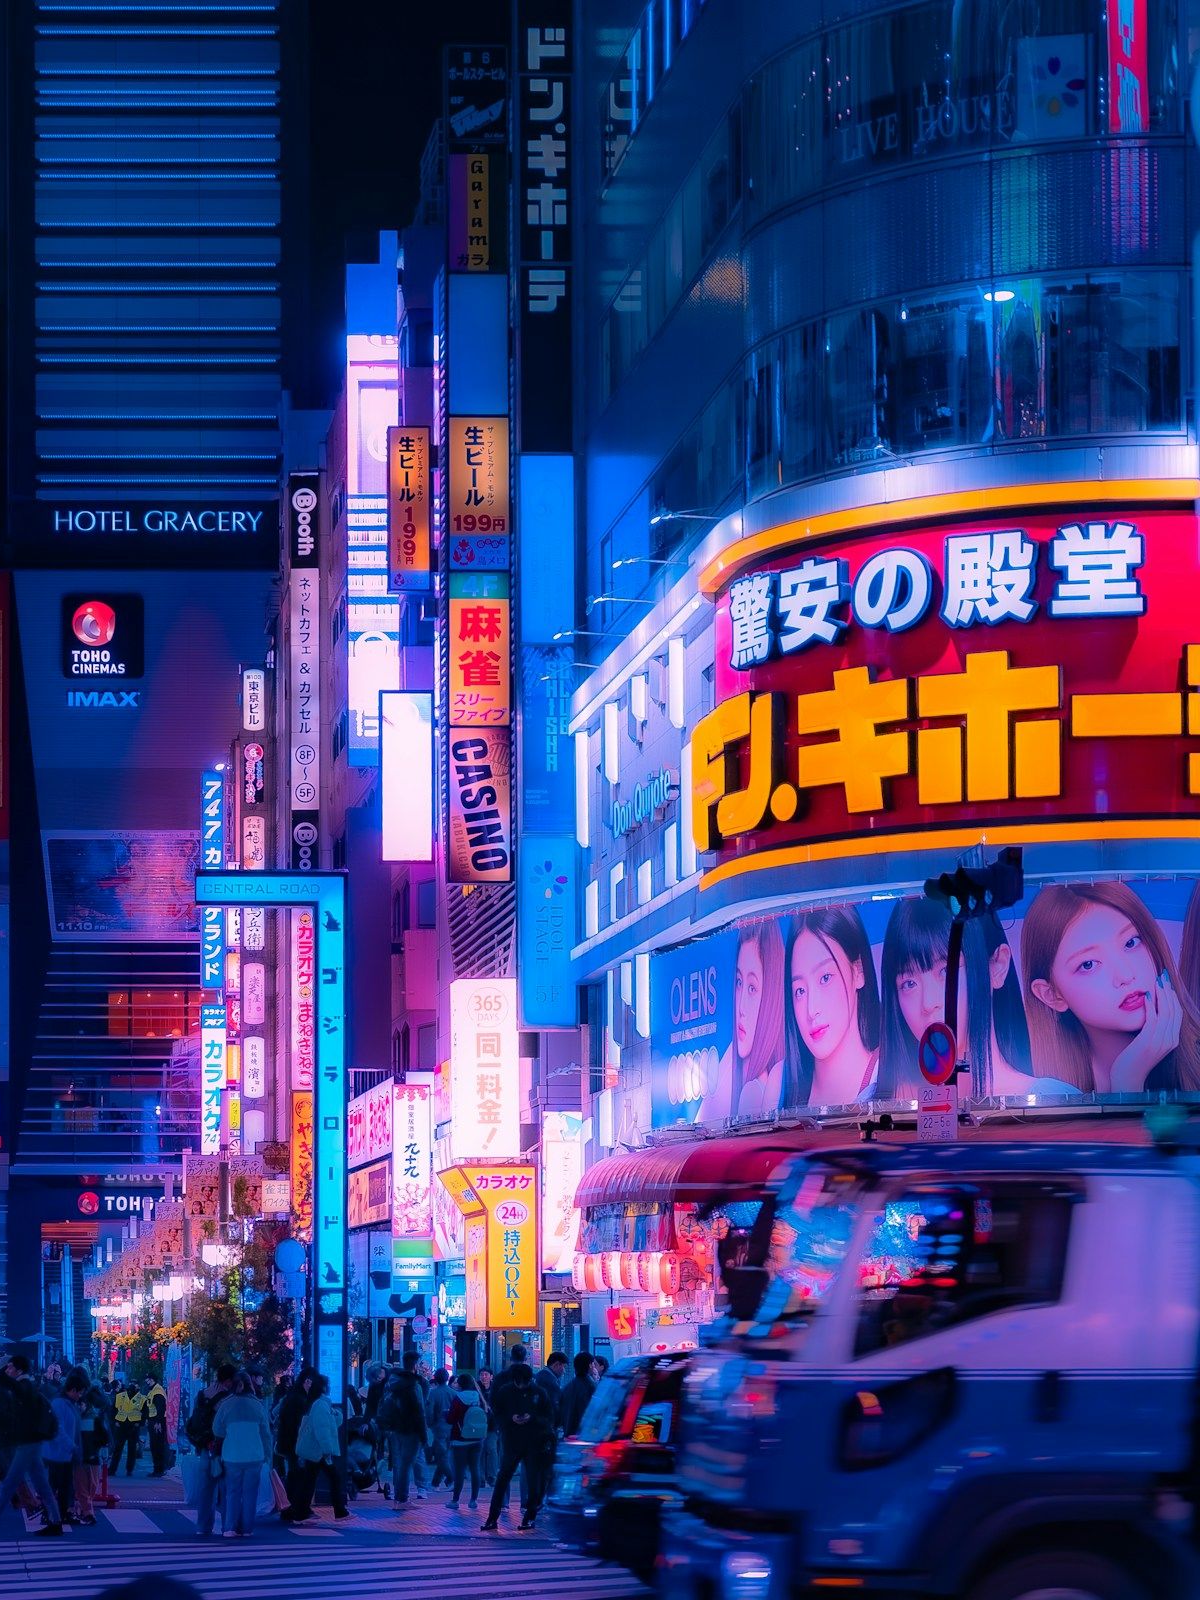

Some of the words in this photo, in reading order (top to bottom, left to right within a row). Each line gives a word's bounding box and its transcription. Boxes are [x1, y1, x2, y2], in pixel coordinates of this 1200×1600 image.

[840, 112, 898, 164] LIVE
[915, 92, 1013, 144] HOUSE
[468, 160, 489, 246] Garam
[398, 436, 416, 503] 生ビール
[464, 426, 485, 507] 生ビール
[54, 510, 138, 532] HOTEL
[144, 510, 263, 532] GRACERY
[291, 487, 318, 556] Booth
[402, 506, 417, 565] 199円
[453, 514, 506, 532] 199円
[462, 574, 498, 597] 4F
[729, 521, 1147, 671] 驚安の殿堂
[299, 577, 312, 656] ネットカフェ
[71, 650, 111, 662] TOHO
[71, 663, 126, 674] CINEMAS
[299, 662, 311, 675] &
[458, 605, 502, 687] 麻雀
[67, 691, 139, 708] IMAX
[248, 681, 260, 726] 東京ビル
[299, 681, 312, 735] カプセル
[453, 707, 508, 722] ファイブ
[454, 693, 495, 706] スリー
[299, 750, 312, 760] 8F
[691, 644, 1200, 853] ドン・キホー
[203, 780, 222, 840] 747
[299, 788, 312, 798] 5F
[451, 737, 509, 873] CASINO
[612, 799, 632, 840] Don
[633, 768, 672, 823] Quijote
[293, 822, 318, 870] Boo
[203, 883, 273, 894] CENTRAL
[279, 883, 321, 894] ROAD
[535, 905, 549, 963] STAGE
[551, 905, 564, 954] IDOL
[298, 926, 314, 986] カラオケ
[203, 1008, 226, 1016] カラオケ
[473, 993, 502, 1011] 365
[476, 1012, 500, 1022] DAYS
[670, 966, 718, 1026] OLENS
[298, 1001, 314, 1087] まねきねこ
[204, 1039, 223, 1132] カラオケ
[322, 966, 343, 1230] ゴジラロード
[476, 1033, 503, 1151] 同一料金!
[403, 1142, 421, 1179] 九十九
[476, 1175, 533, 1190] カラオケ
[264, 1183, 289, 1195] 雀荘
[501, 1205, 524, 1221] 24H
[395, 1262, 432, 1271] FamilyMart
[503, 1229, 521, 1317] 持込OK!
